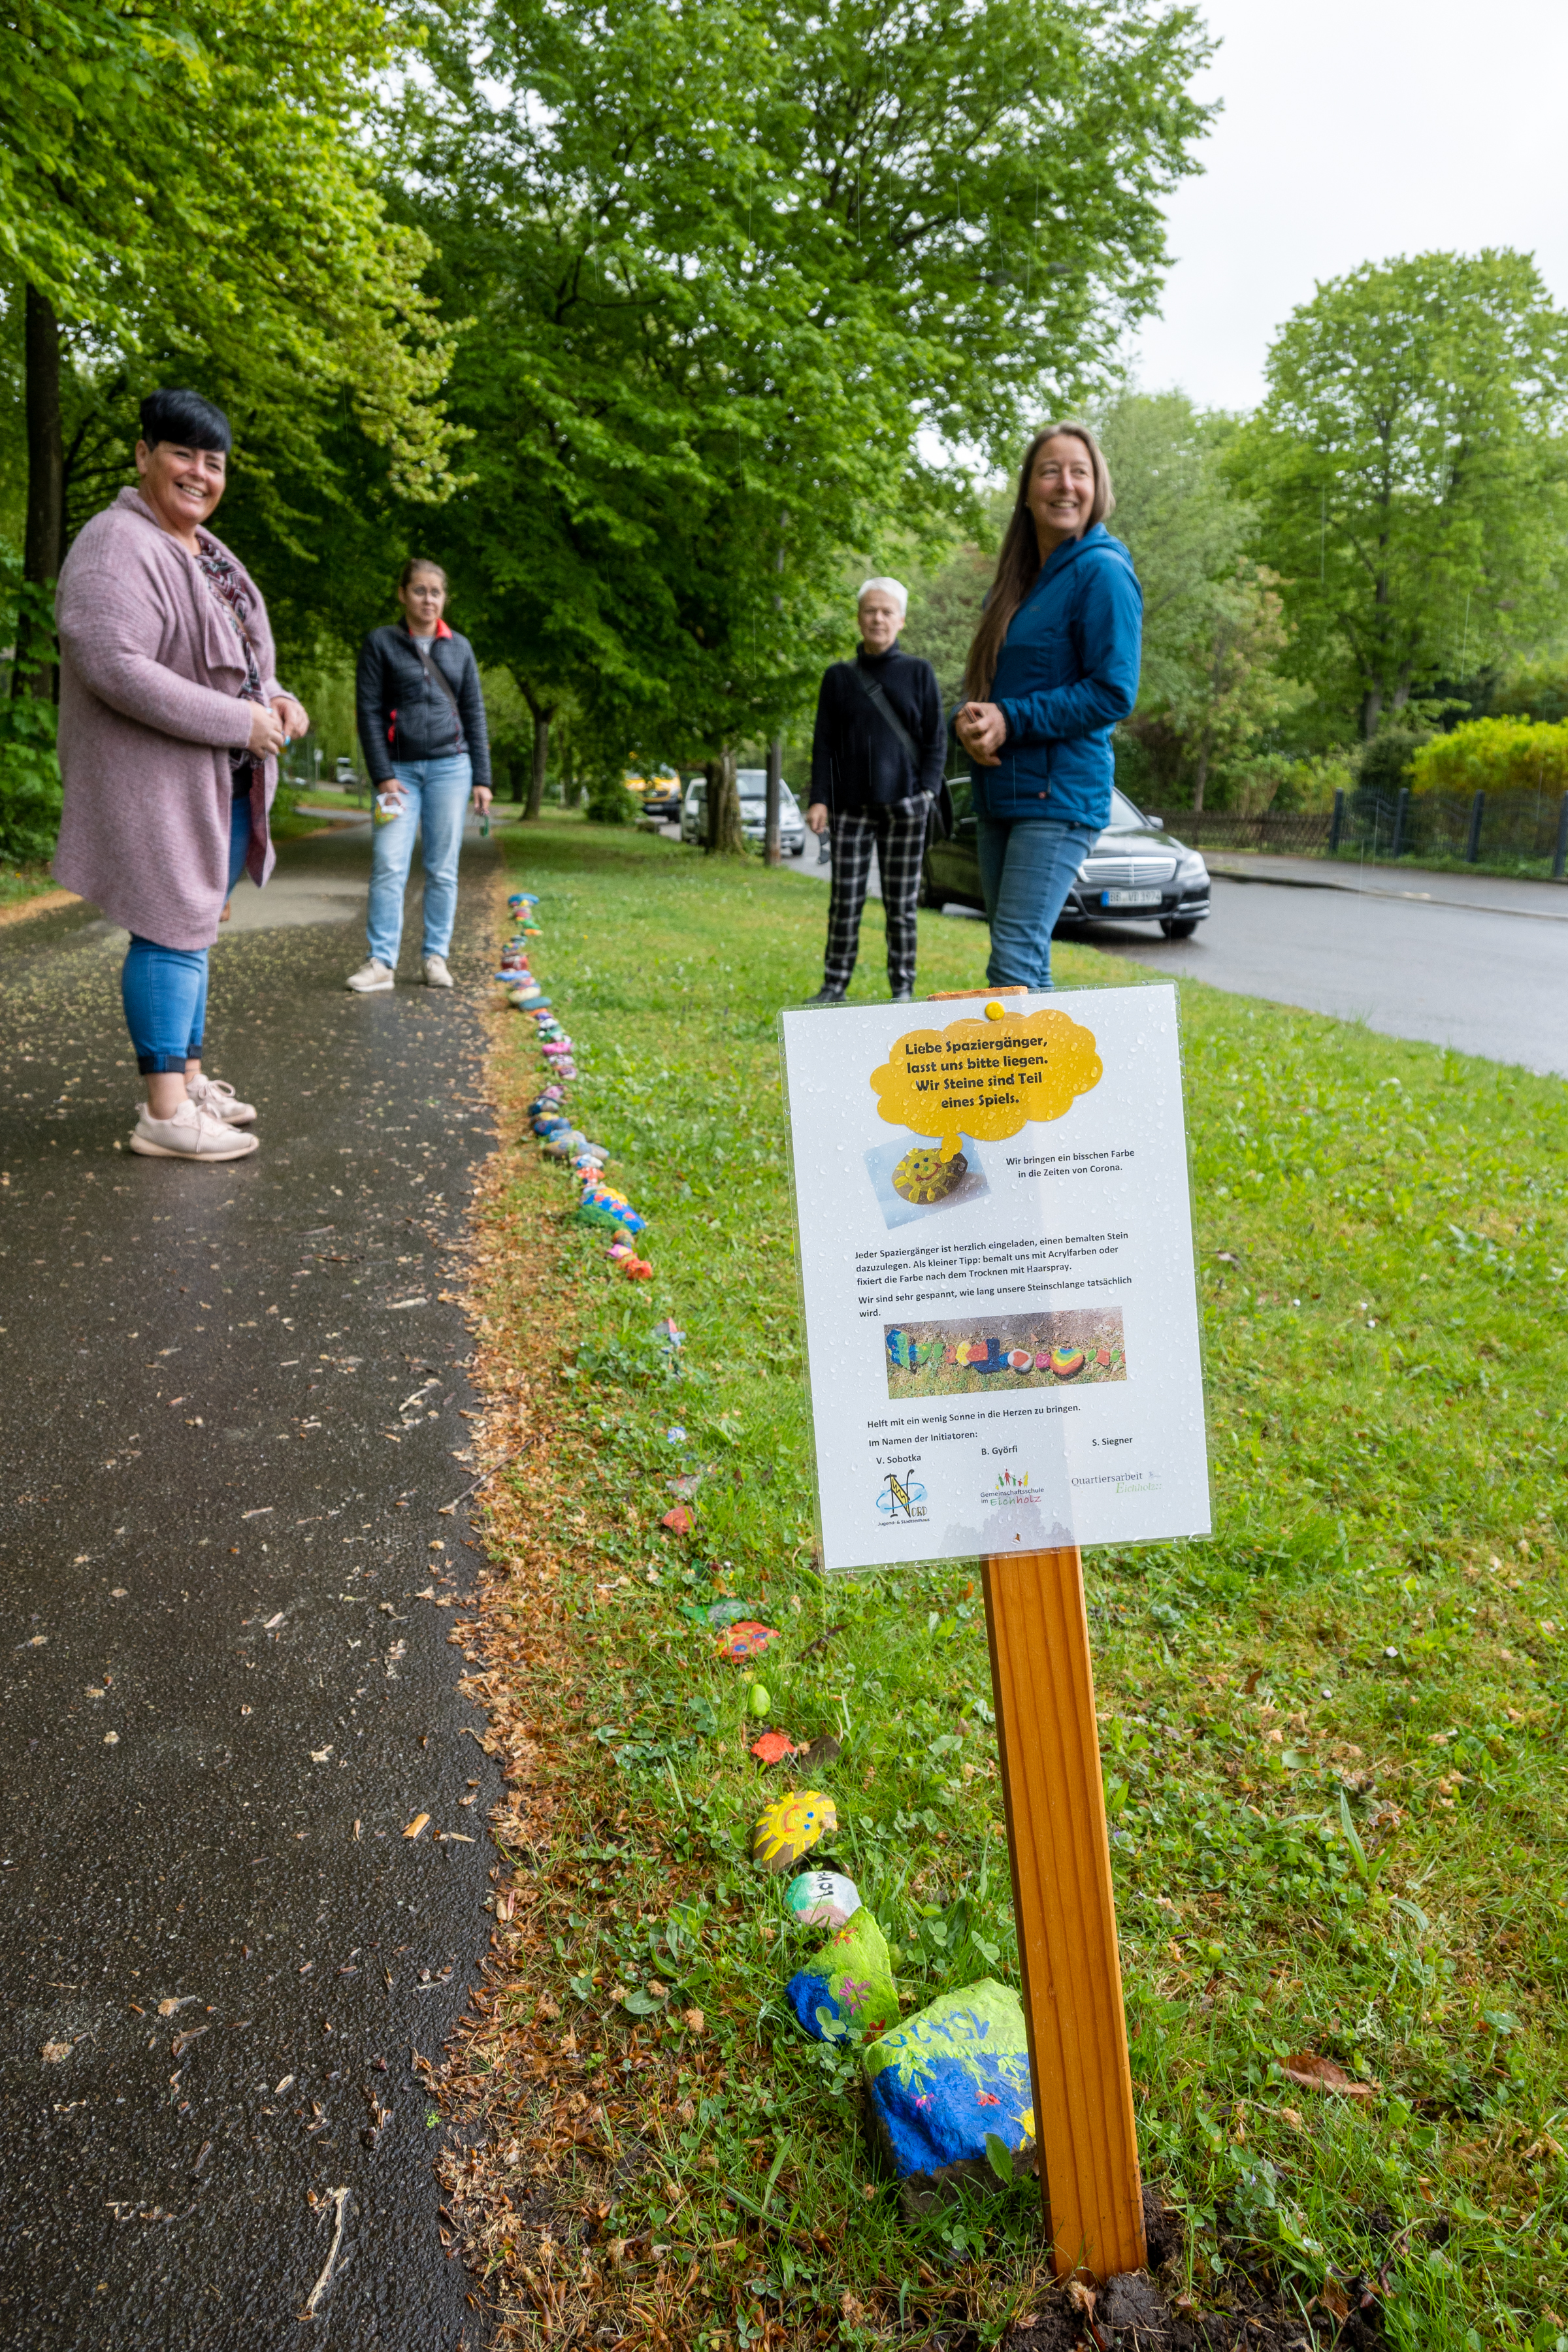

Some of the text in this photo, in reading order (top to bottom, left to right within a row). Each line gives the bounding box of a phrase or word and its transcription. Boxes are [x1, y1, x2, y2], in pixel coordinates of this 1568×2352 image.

[905, 1036, 1048, 1056] Liebe Spaziergänger,
[906, 1054, 1049, 1074] lasst uns bitte liegen.
[915, 1070, 1043, 1092] Wir Steine sind Teil
[941, 1092, 1020, 1109] eines Spiels.
[1005, 1149, 1135, 1166] Wir bringen ein bisschen Farbe
[1018, 1169, 1026, 1179] in
[1028, 1169, 1041, 1178] die
[1043, 1168, 1070, 1177] Zeiten
[1090, 1164, 1122, 1173] Corona.
[855, 1232, 1128, 1260] Jeder Spaziergänger ist herzlich eingeladen, einen bemalten Stein
[856, 1262, 911, 1273] dazuzulegen.
[913, 1259, 926, 1269] Als
[928, 1258, 958, 1267] kleiner
[958, 1256, 981, 1266] Tipp:
[983, 1252, 1013, 1264] bemalt
[1032, 1250, 1047, 1260] mit
[1048, 1247, 1097, 1259] Acrylfarben
[1099, 1245, 1119, 1254] oder
[857, 1264, 1072, 1286] fixiert die Farbe nach dem Trocknen mit Haarspray.
[858, 1275, 1132, 1305] Wir sind sehr gespannt, wie lang unsere Steinschlange tatsächlich
[858, 1307, 881, 1318] wird.
[867, 1418, 889, 1429] Helft
[890, 1417, 905, 1427] mit
[921, 1414, 947, 1424] wenig
[949, 1413, 975, 1422] Sonne
[977, 1411, 985, 1420] in
[987, 1409, 1001, 1419] die
[1003, 1409, 1032, 1418] Herzen
[1046, 1405, 1081, 1414] bringen.
[881, 1437, 912, 1446] Namen
[914, 1434, 929, 1444] der
[930, 1431, 978, 1442] Initiatoren:
[1092, 1437, 1133, 1447] S. Siegner
[981, 1444, 1018, 1456] B. Györfi
[875, 1453, 921, 1465] V. Sobotka
[1071, 1472, 1143, 1486] Quartiersarbeit
[980, 1488, 1045, 1497] Gemeinschaftsschule
[990, 1495, 1041, 1506] Eichholz
